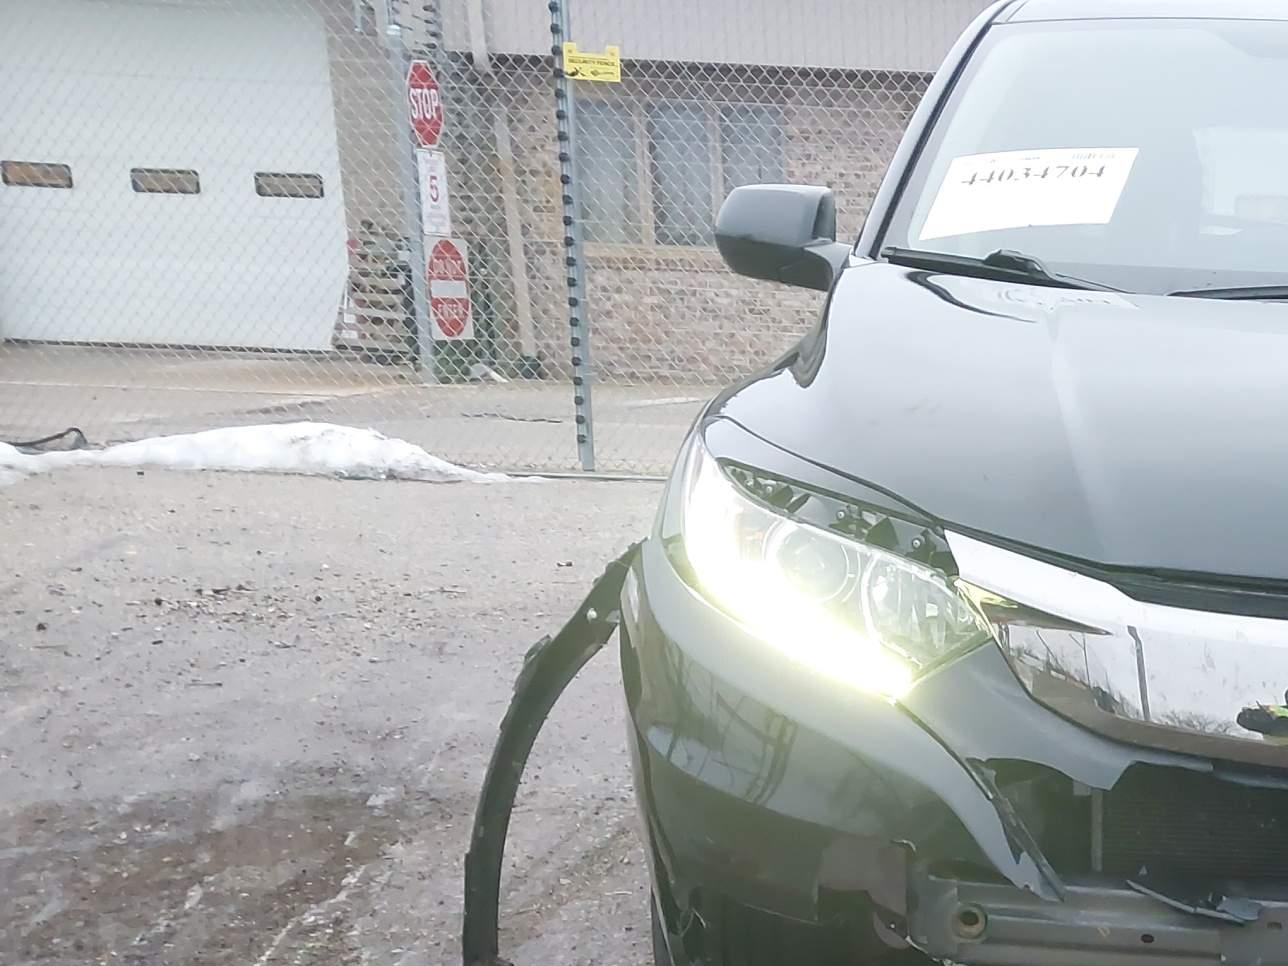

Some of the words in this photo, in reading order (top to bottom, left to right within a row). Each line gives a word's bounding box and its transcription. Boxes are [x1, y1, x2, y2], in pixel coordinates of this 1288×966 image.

[409, 88, 439, 120] STOP
[429, 175, 440, 203] 5
[961, 164, 1106, 186] 44034704
